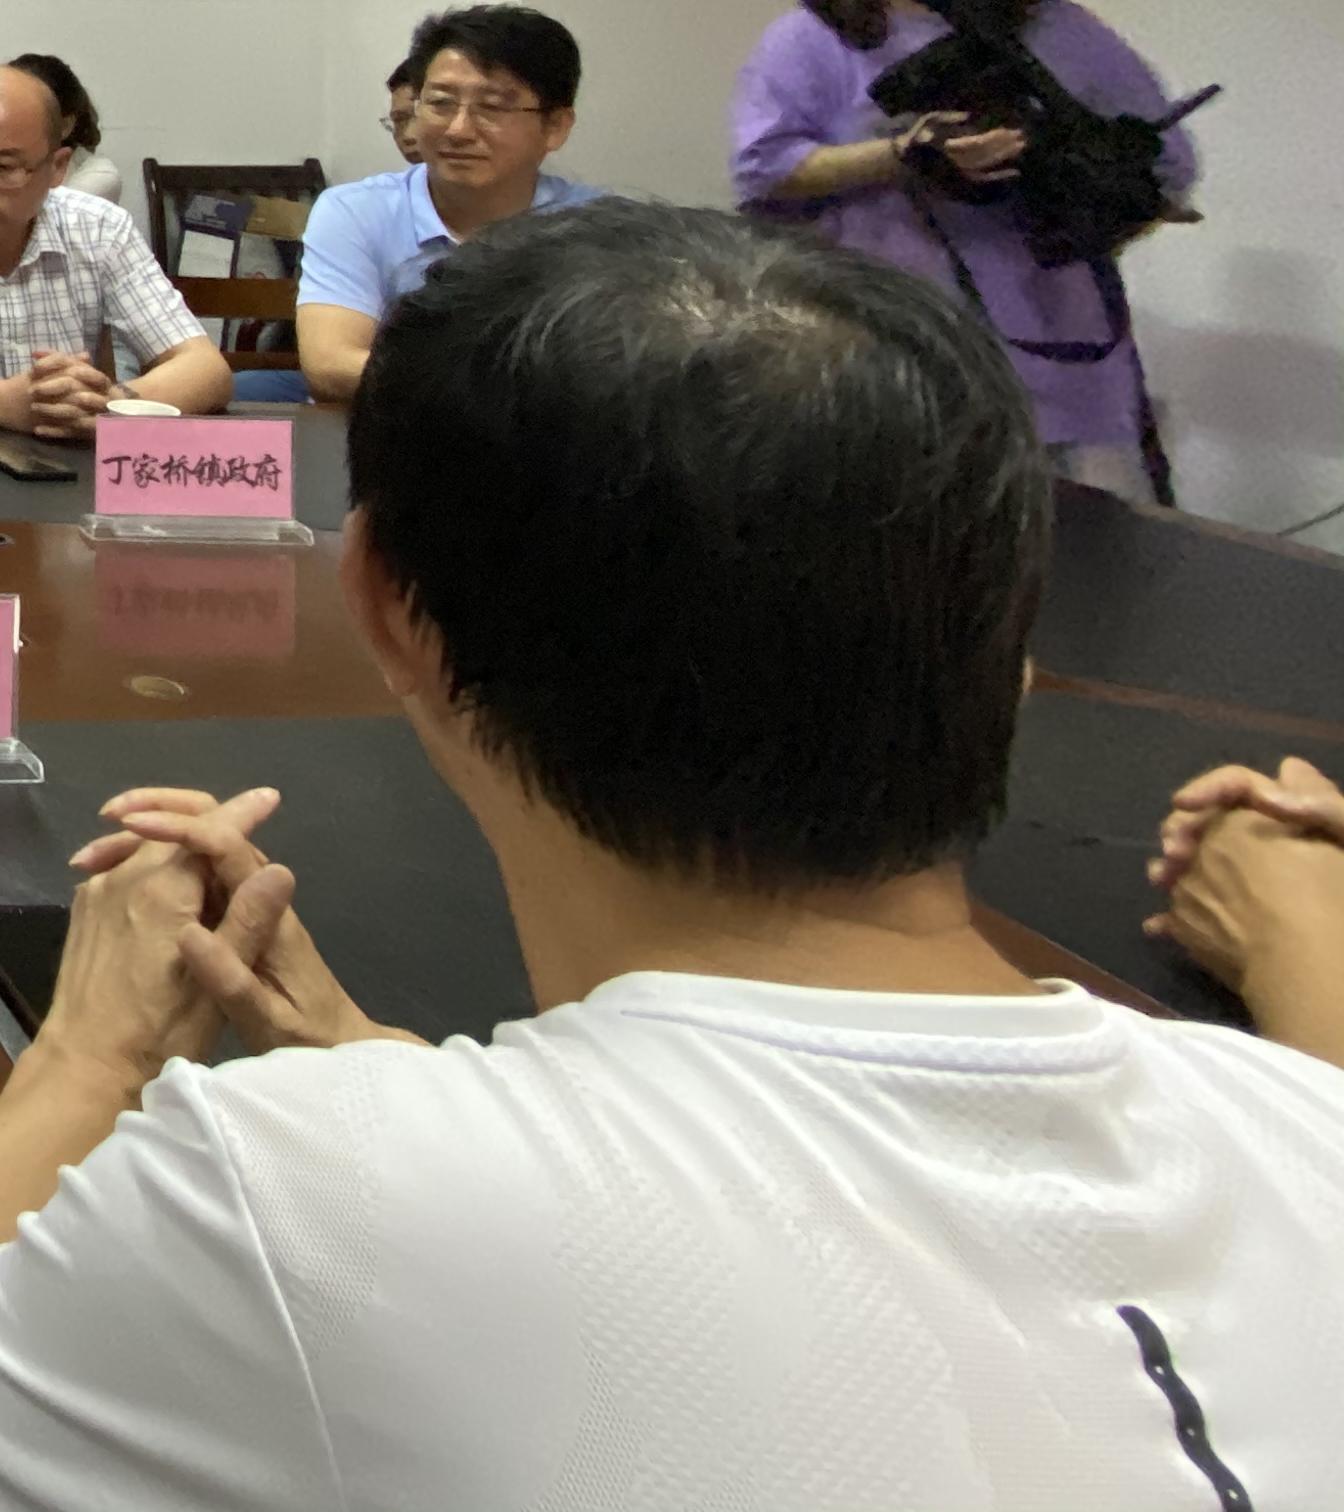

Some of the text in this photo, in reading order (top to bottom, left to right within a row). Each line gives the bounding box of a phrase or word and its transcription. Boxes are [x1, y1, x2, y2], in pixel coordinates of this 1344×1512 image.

[101, 453, 282, 492] 丁家桥镇政府
